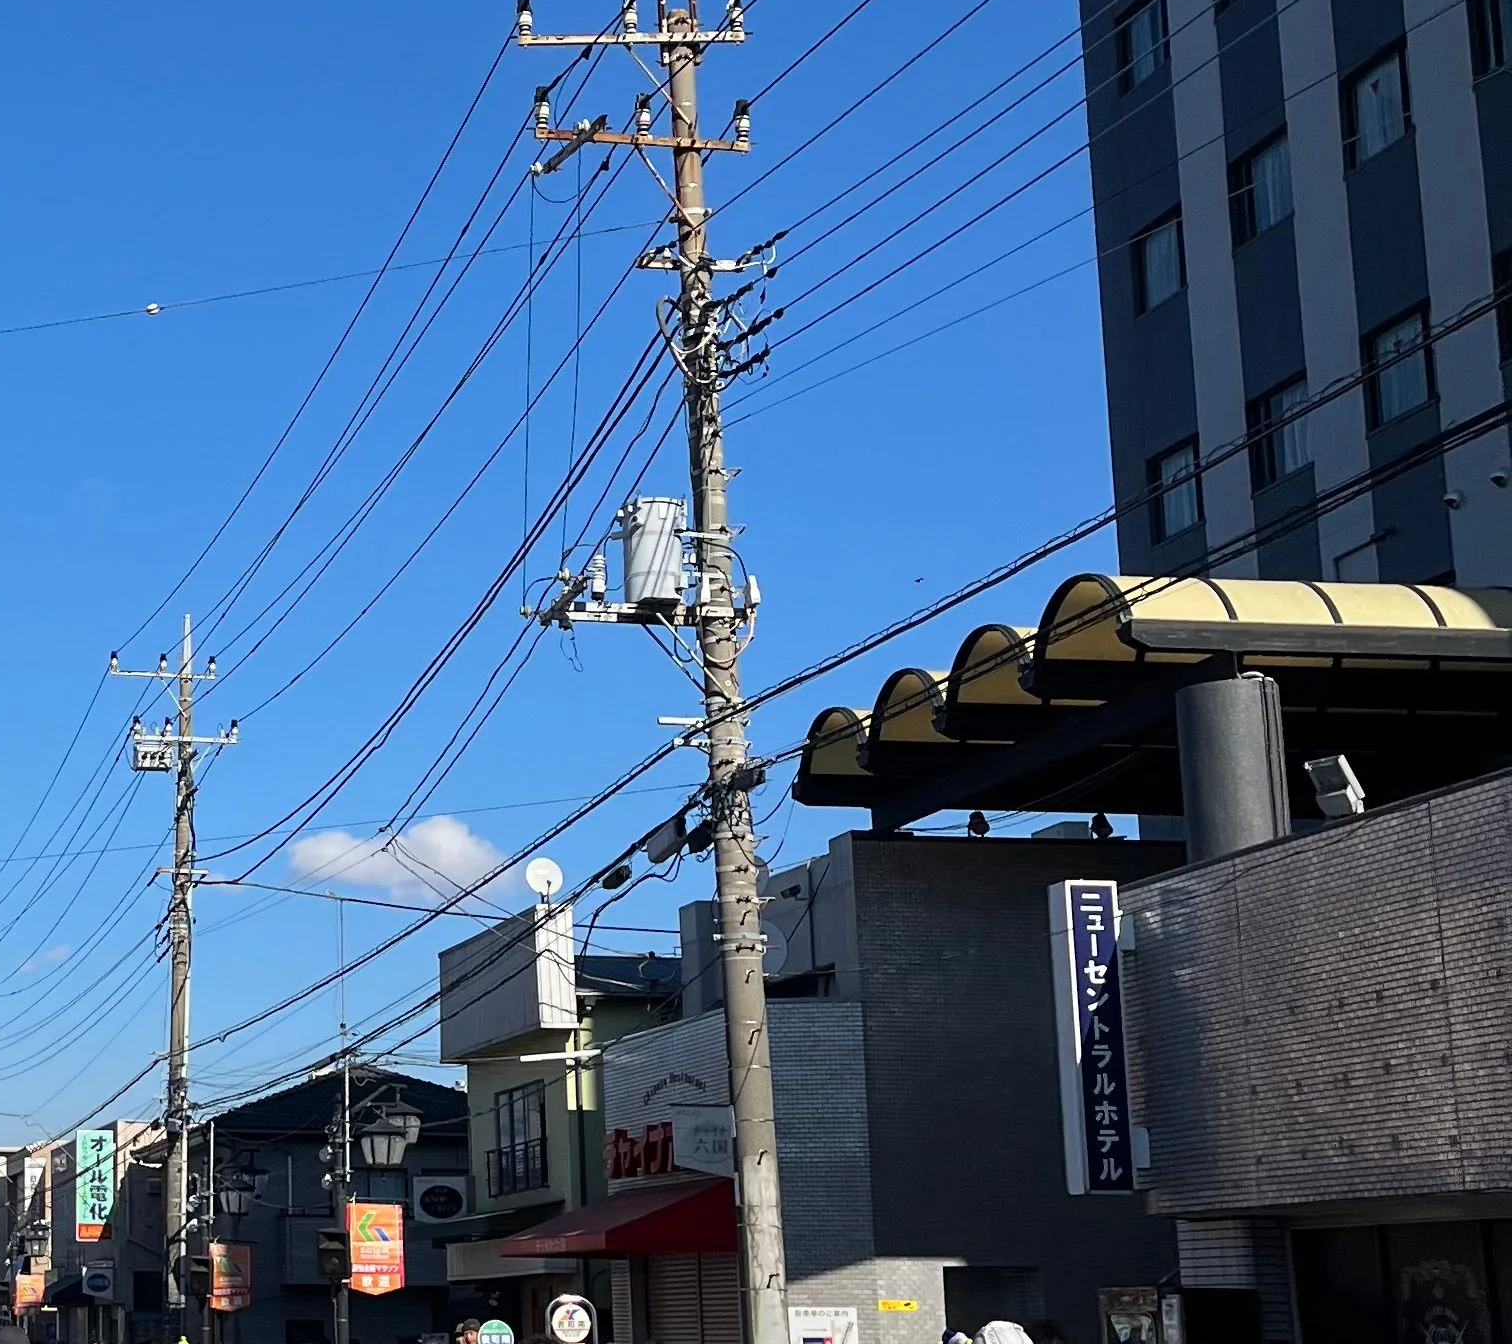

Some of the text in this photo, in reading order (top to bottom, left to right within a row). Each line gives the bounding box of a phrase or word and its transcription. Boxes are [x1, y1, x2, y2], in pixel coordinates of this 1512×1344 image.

[1079, 891, 1124, 1184] ニューセントラルホテル
[89, 1135, 108, 1221] オール電化
